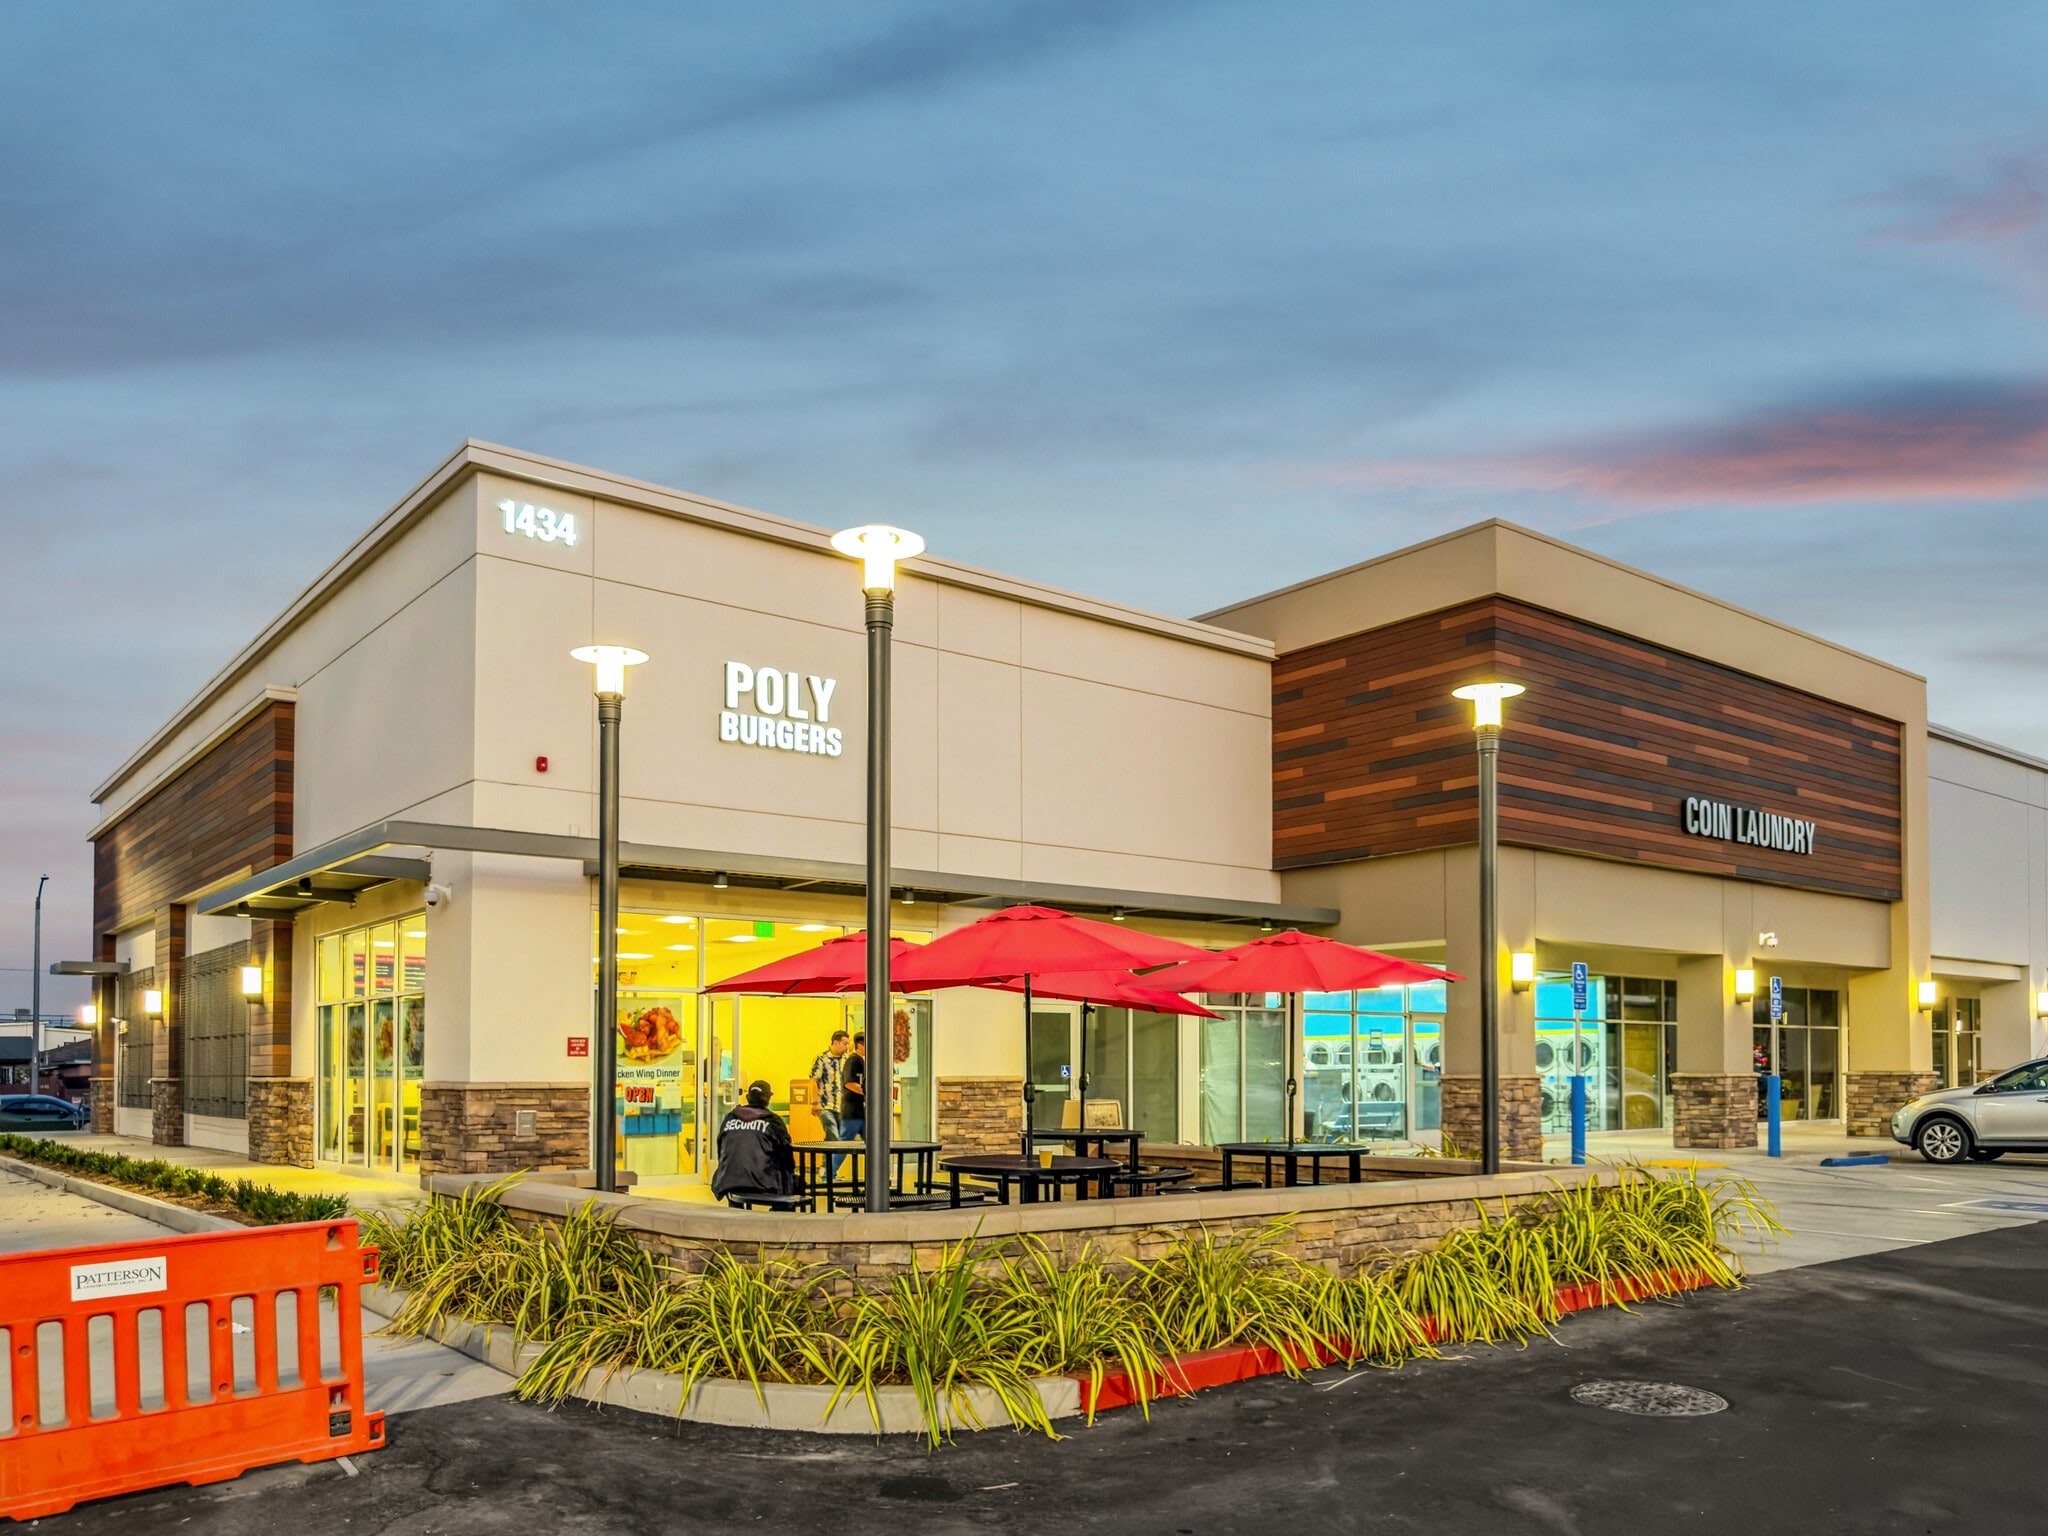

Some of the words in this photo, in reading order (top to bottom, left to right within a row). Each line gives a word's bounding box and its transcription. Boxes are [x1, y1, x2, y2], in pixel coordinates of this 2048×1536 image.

[498, 499, 577, 546] 1434
[724, 660, 837, 723] POLY
[719, 710, 842, 757] BURGERS
[1682, 796, 1732, 840] COIN
[1735, 806, 1816, 855] LAUNDRY
[617, 1070, 635, 1078] cken
[636, 1069, 655, 1079] Wing
[656, 1069, 680, 1078] Dinner
[625, 1086, 654, 1103] OPEN
[724, 1119, 769, 1133] SECURITY
[76, 1266, 161, 1290] PATTERSON
